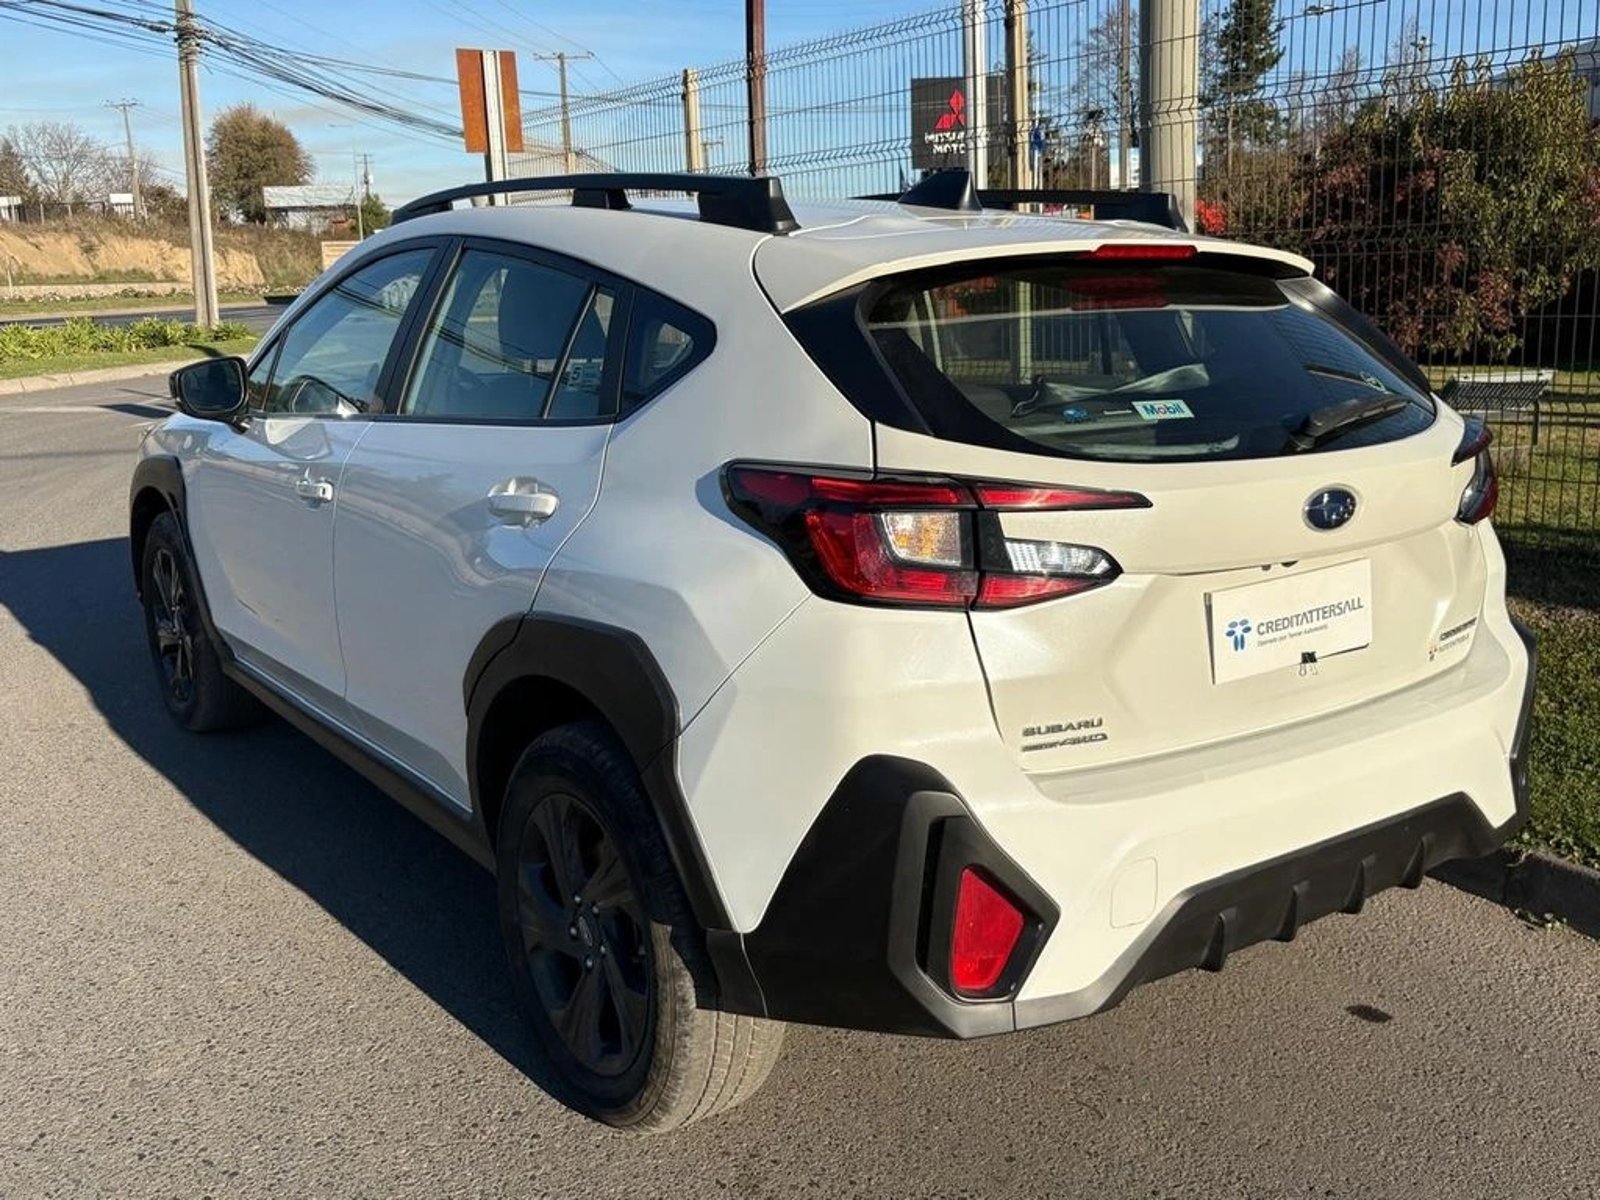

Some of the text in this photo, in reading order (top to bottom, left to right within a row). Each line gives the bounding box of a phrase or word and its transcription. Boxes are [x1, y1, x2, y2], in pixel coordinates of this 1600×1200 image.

[932, 143, 966, 154] MOTO
[1142, 403, 1185, 415] Mobil
[1256, 597, 1364, 636] CREDITATTERSALL
[1022, 717, 1103, 737] SUBARU
